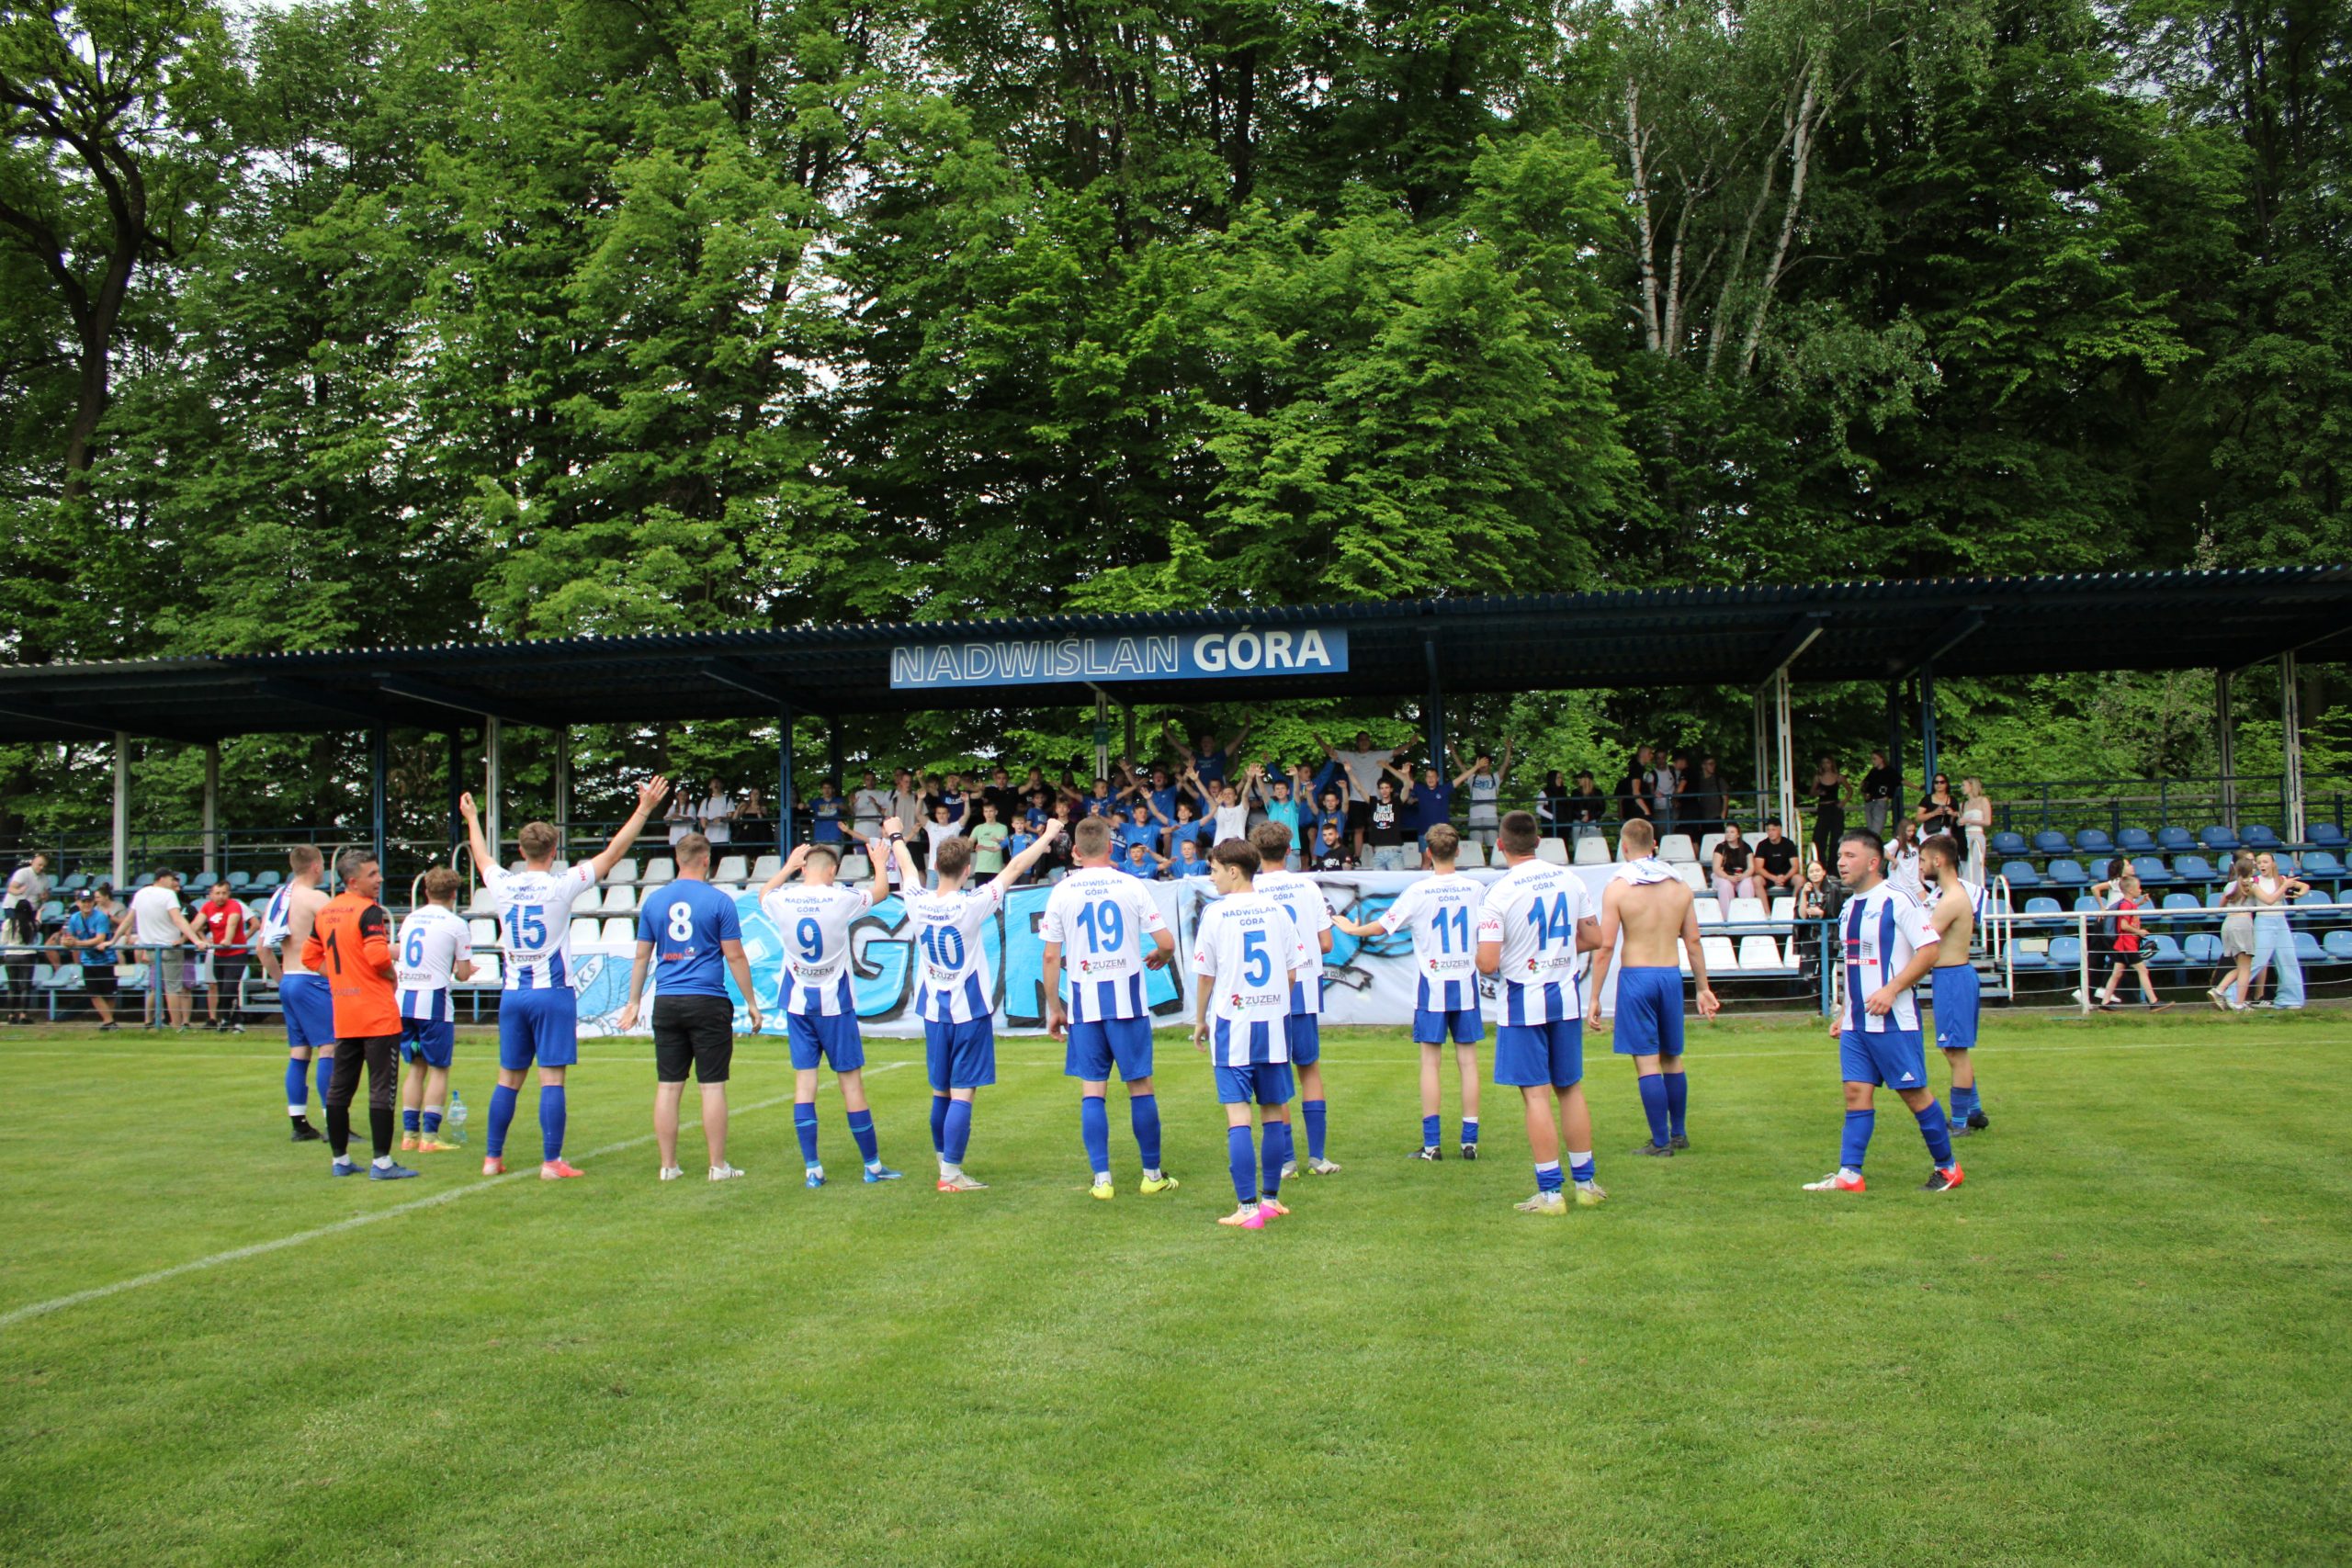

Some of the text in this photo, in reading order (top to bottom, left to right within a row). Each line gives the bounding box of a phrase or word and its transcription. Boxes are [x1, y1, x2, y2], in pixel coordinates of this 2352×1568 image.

[893, 624, 1332, 682] NADWIŚLAN GÓRA
[1084, 888, 1110, 897] GÓRA
[1272, 892, 1295, 901] GÓRA
[1532, 881, 1556, 891] GÓRA
[505, 904, 547, 950] 15
[668, 901, 694, 942] 8
[797, 917, 823, 964] 9
[1077, 899, 1124, 953] 19
[1239, 917, 1265, 927] GÓRA
[1431, 906, 1468, 953] 11
[1527, 891, 1571, 951] 14
[326, 929, 342, 976] 1
[405, 927, 426, 969] 6
[920, 924, 965, 971] 10
[1092, 958, 1126, 970] ZUZEMI
[1243, 930, 1272, 987] 5
[1541, 957, 1571, 969] ZUZEMI
[801, 965, 835, 976] ZUZEMI
